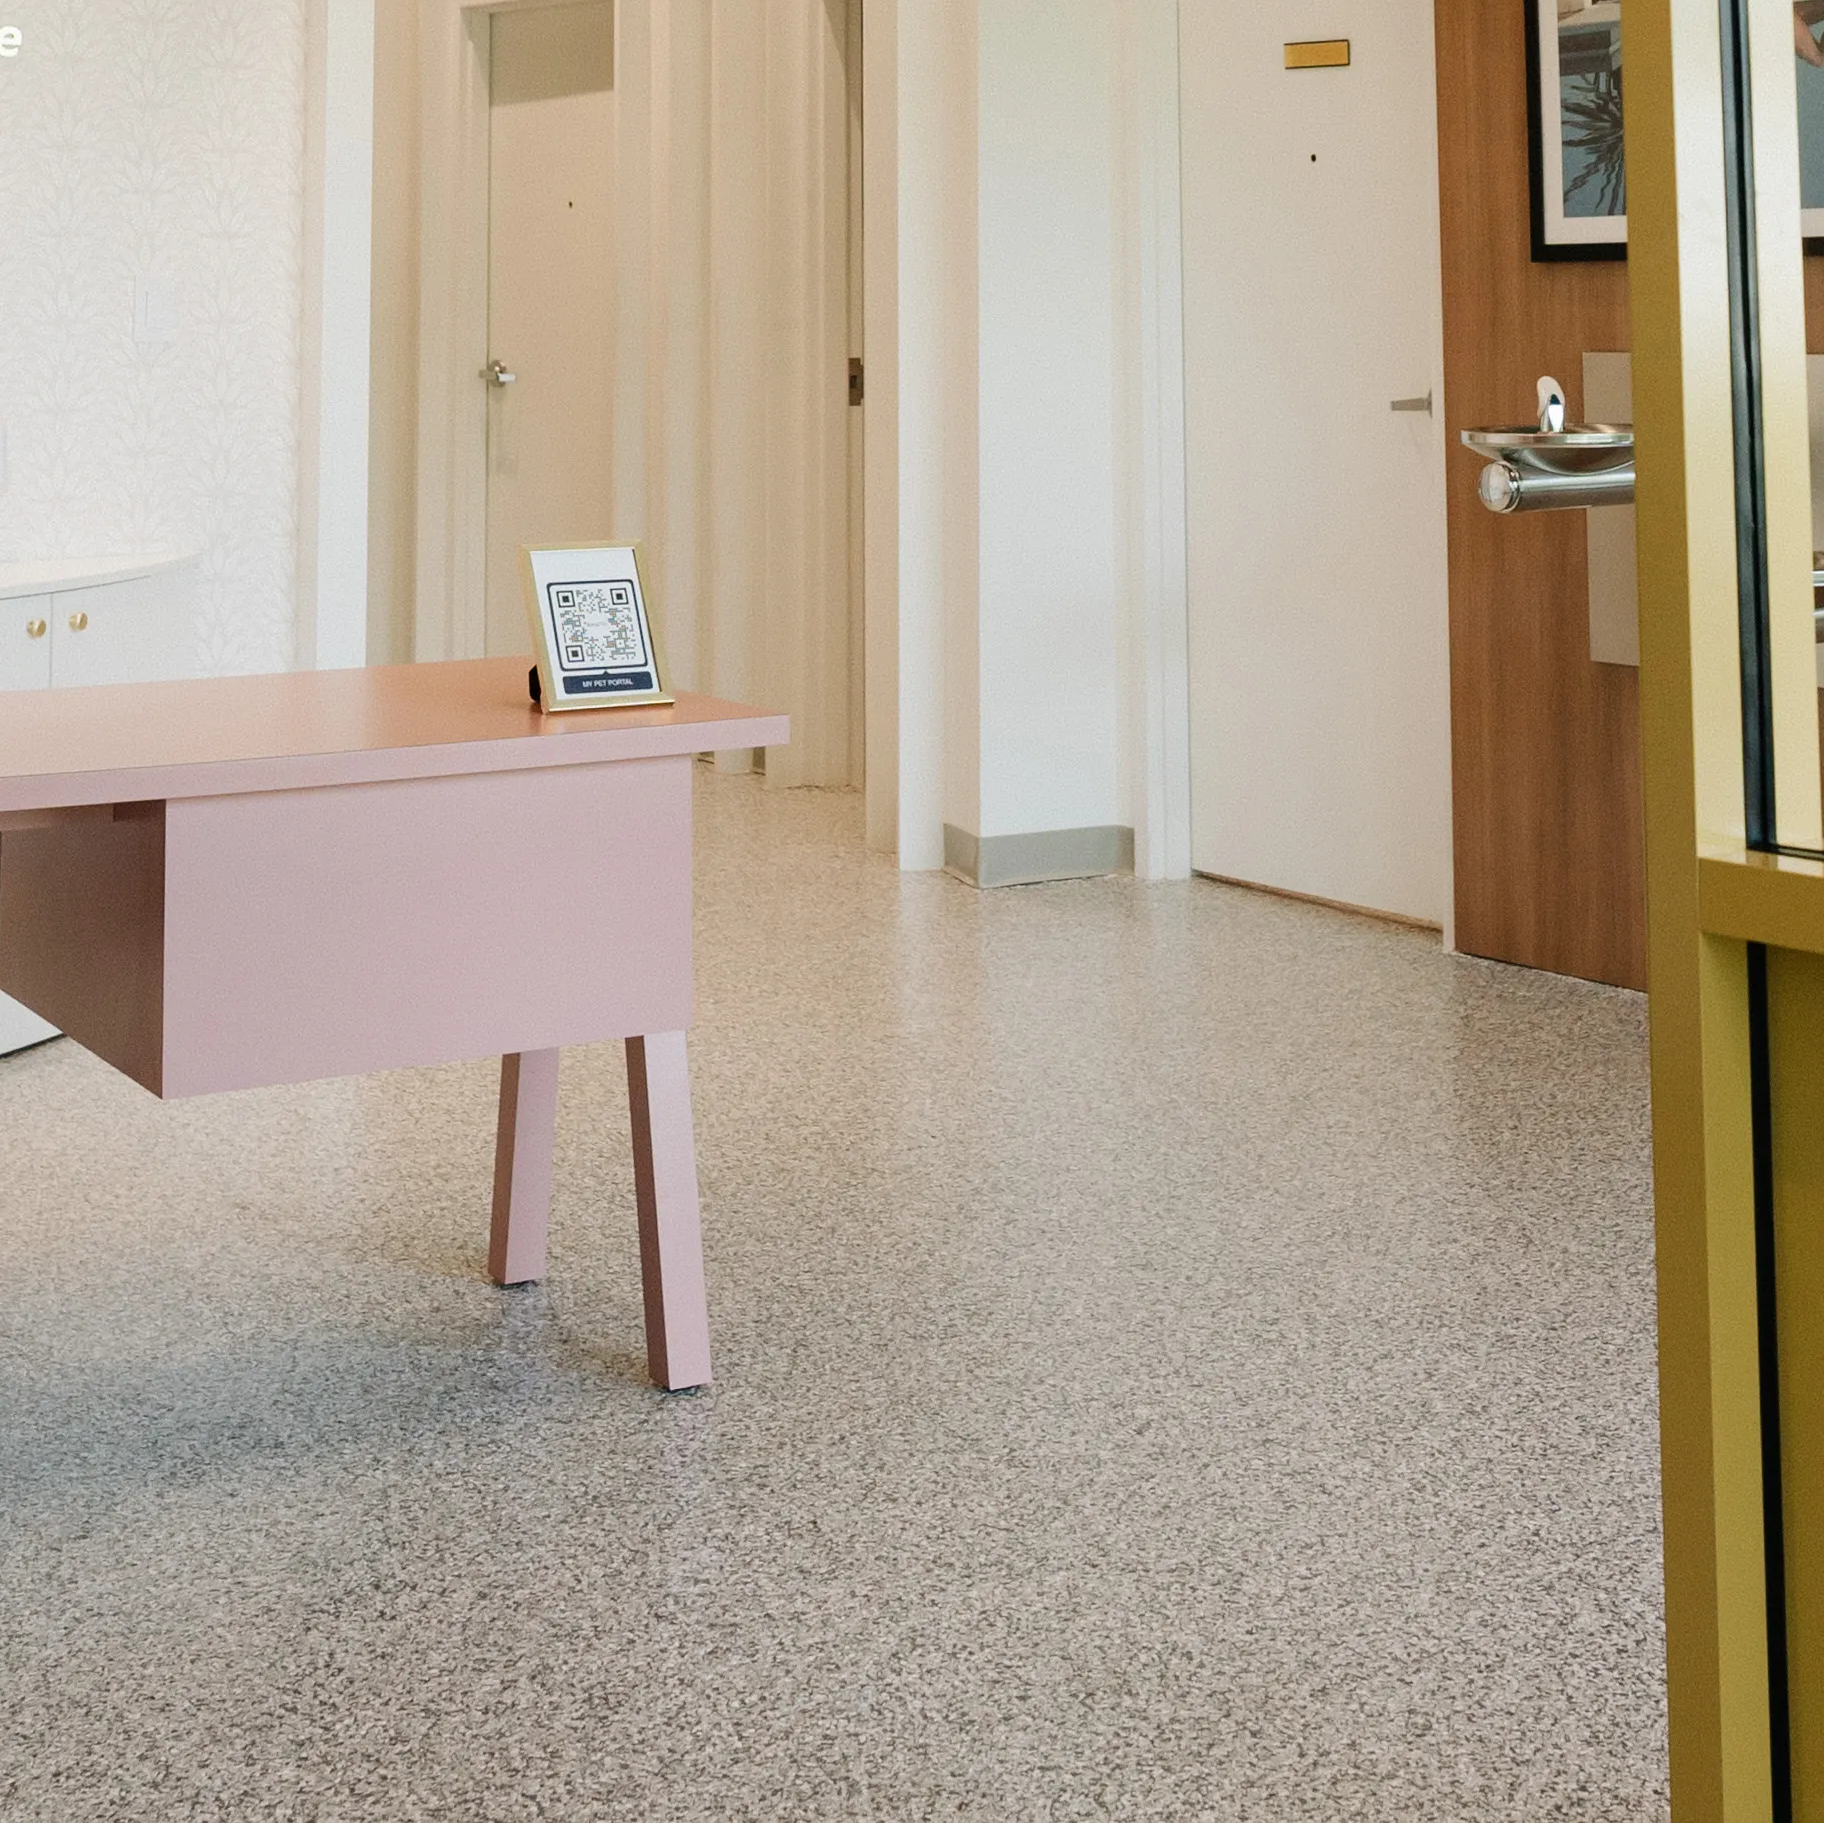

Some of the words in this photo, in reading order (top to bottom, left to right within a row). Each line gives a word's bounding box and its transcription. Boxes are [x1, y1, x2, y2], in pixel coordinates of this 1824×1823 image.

[582, 680, 592, 688] MY
[594, 679, 607, 687] PET
[608, 678, 634, 686] PORTAL
